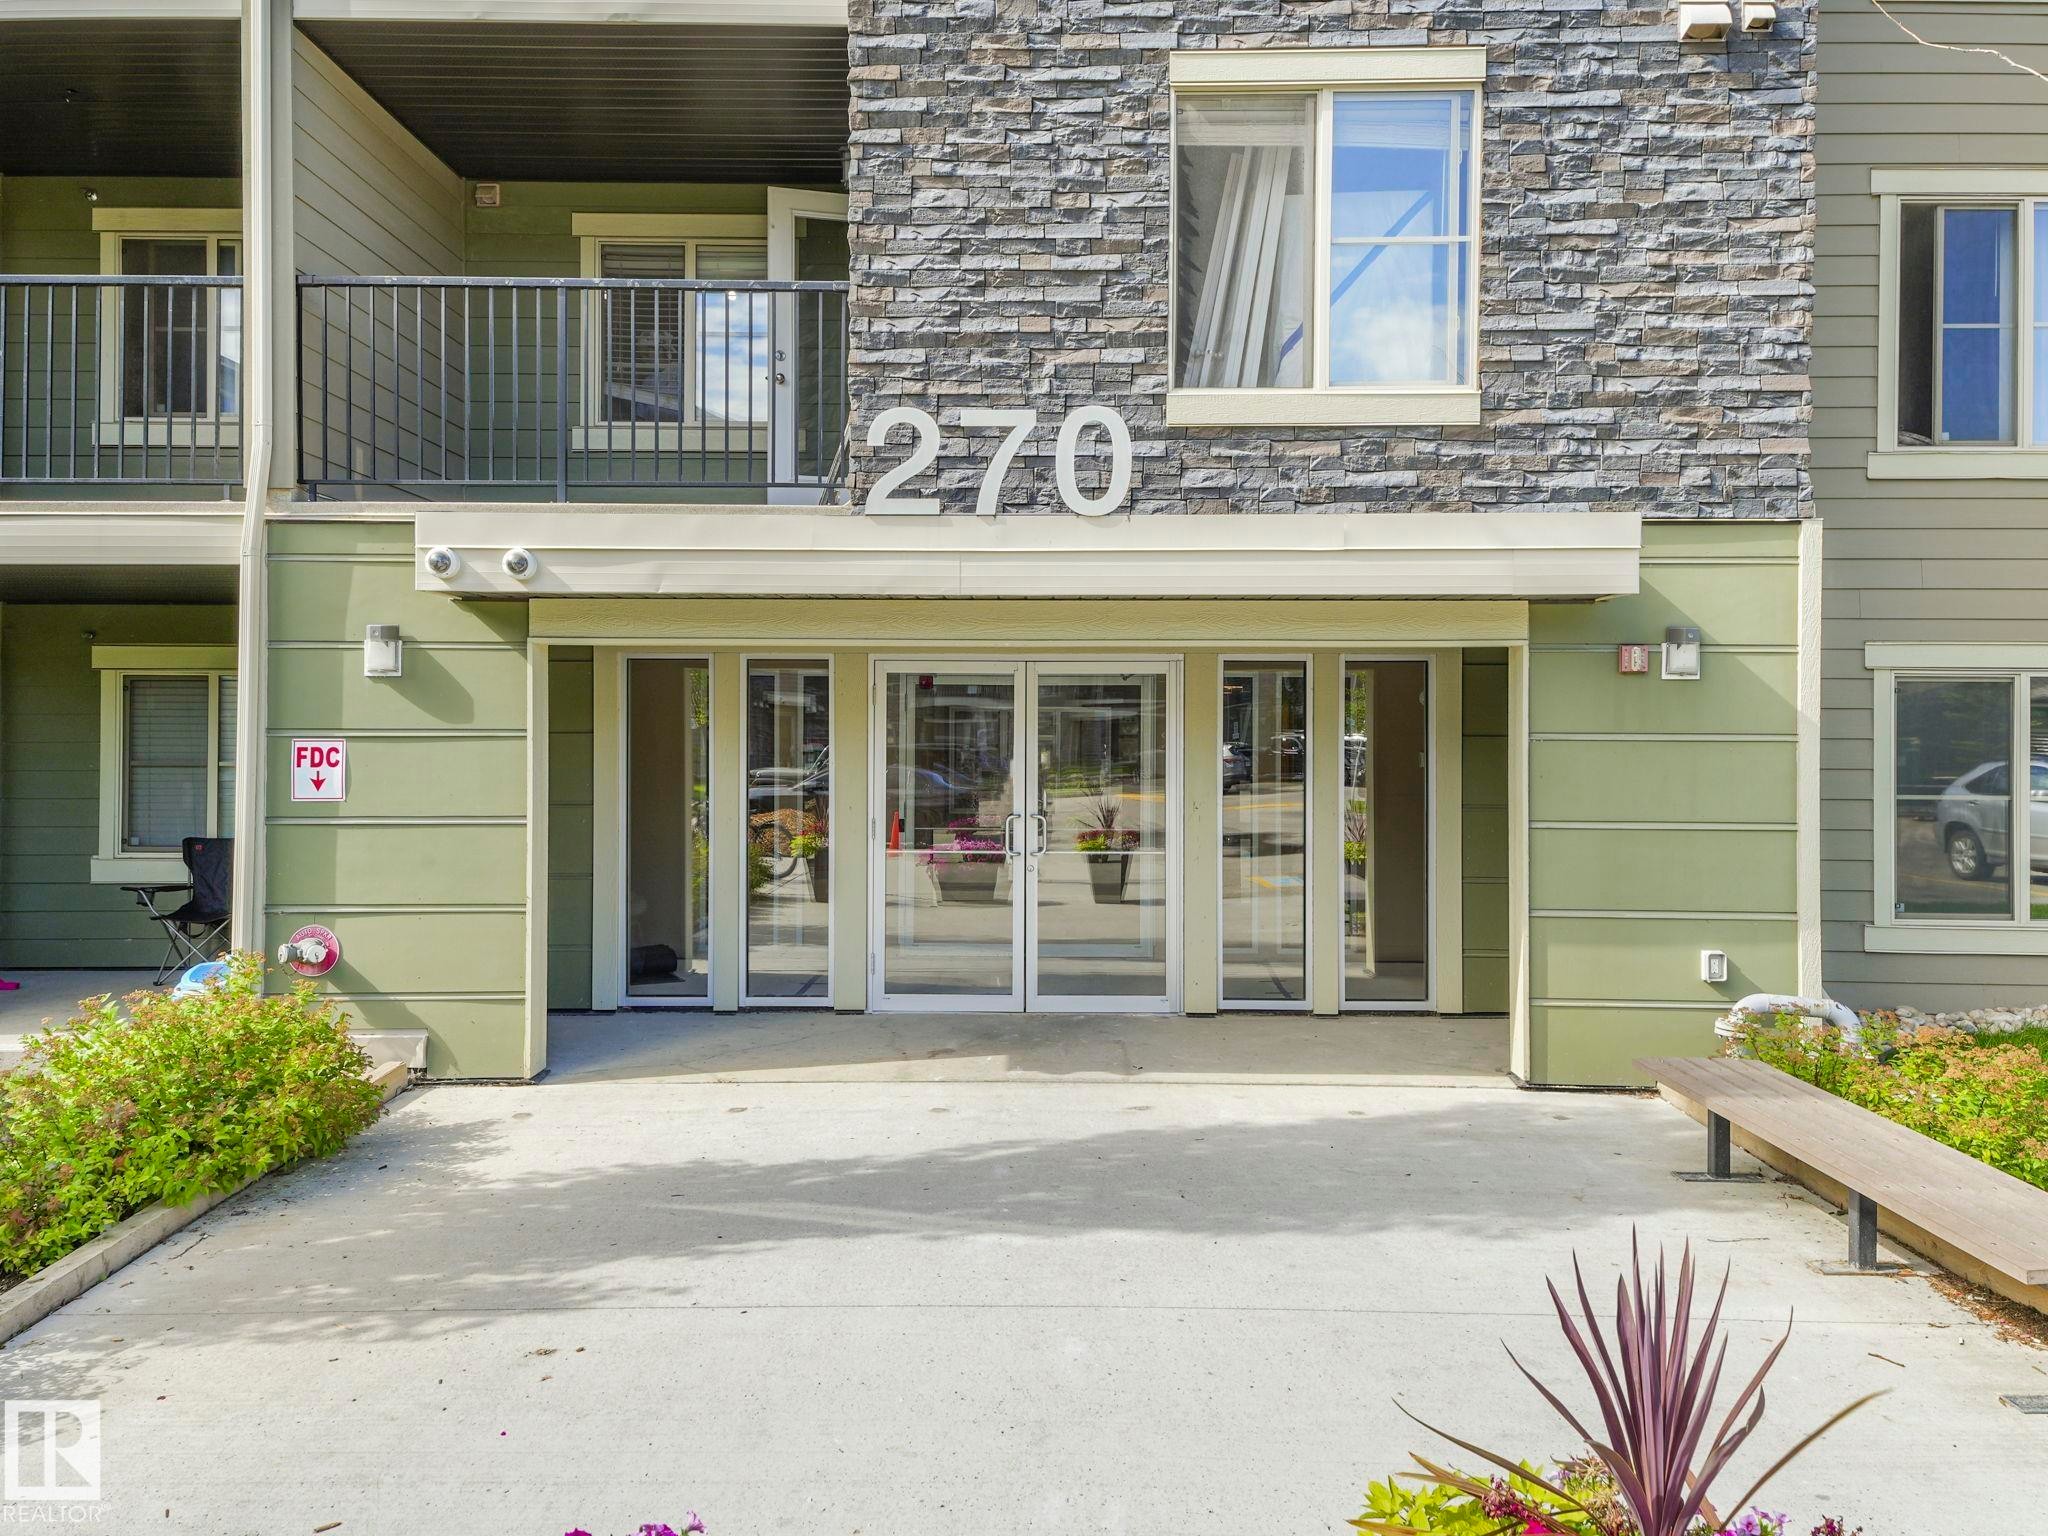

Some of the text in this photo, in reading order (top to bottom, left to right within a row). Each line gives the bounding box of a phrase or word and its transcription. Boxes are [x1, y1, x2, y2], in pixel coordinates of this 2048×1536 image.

[865, 406, 1132, 516] 270
[296, 747, 340, 768] FDC
[296, 928, 312, 940] AUTO
